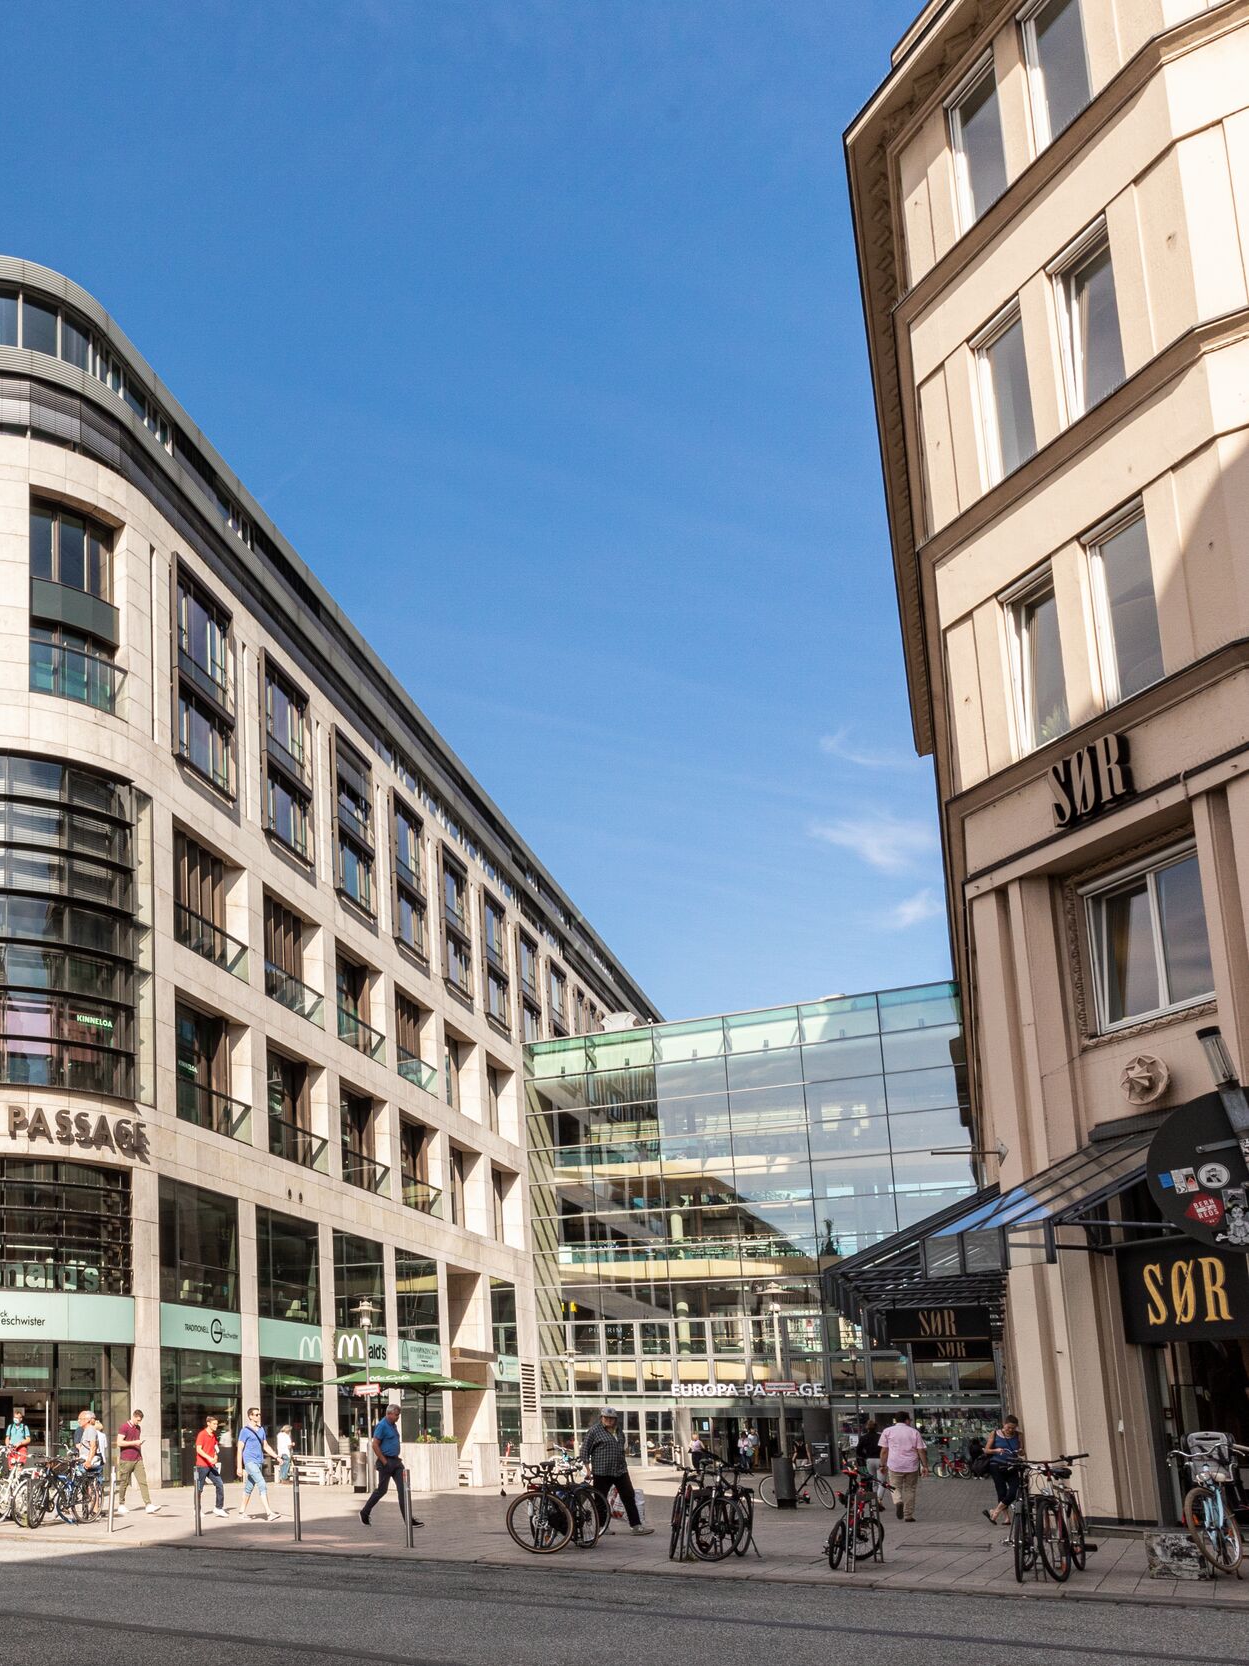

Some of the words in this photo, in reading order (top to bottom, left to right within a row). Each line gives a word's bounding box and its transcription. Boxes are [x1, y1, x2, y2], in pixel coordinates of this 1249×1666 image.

[1047, 733, 1128, 828] SØR
[76, 1014, 113, 1028] KINNELOA
[8, 1105, 148, 1151] PASSAGE
[1143, 1257, 1234, 1325] SØR
[918, 1309, 957, 1336] SØR
[936, 1341, 967, 1358] SØR
[671, 1383, 739, 1397] EUROPA
[744, 1383, 825, 1397] PAGE
